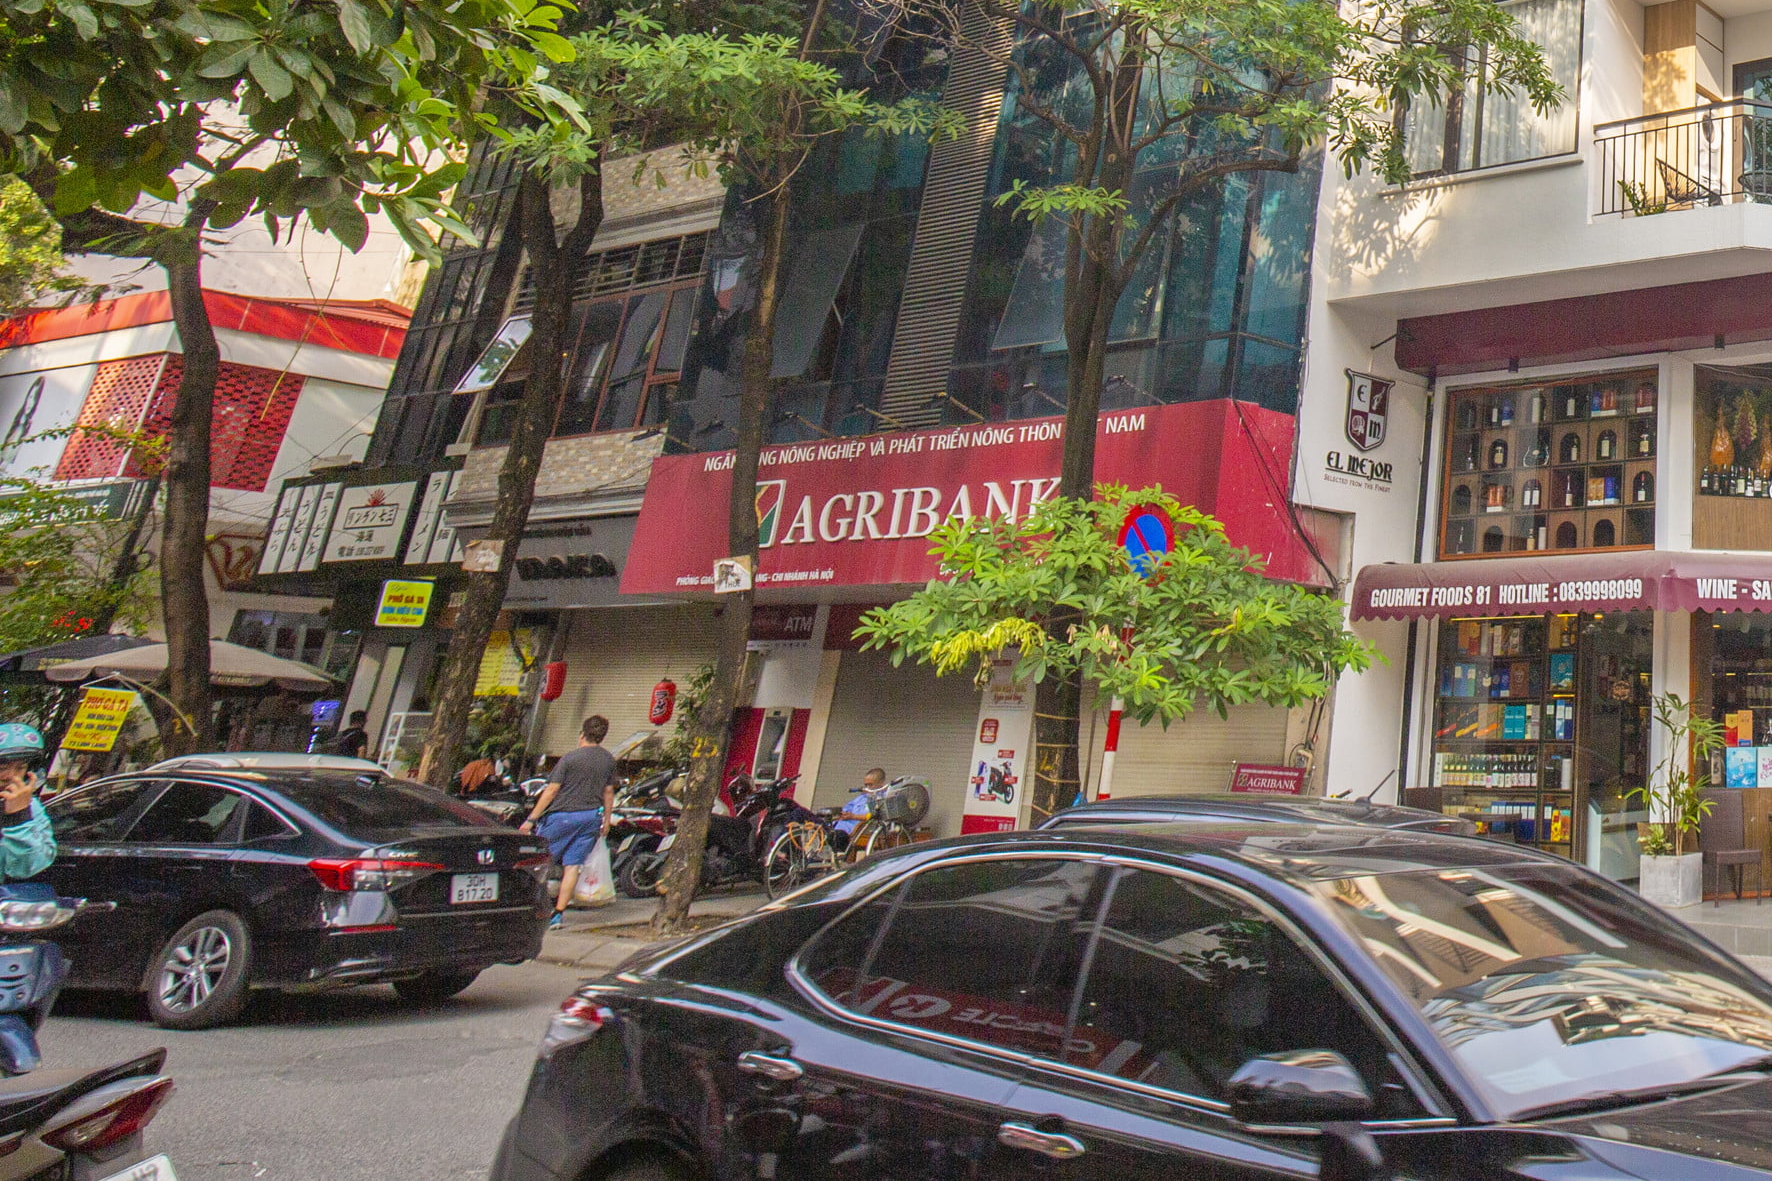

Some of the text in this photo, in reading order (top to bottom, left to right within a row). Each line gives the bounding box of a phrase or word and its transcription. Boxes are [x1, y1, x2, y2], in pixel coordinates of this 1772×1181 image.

[778, 446, 815, 465] NÔNG
[817, 441, 865, 462] NGHIỆP
[870, 437, 885, 457] VÀ
[889, 433, 925, 455] PHÁT
[929, 426, 969, 451] TRIỂN
[972, 426, 1014, 447] NÔNG
[1019, 423, 1062, 443] THÔN
[1105, 414, 1145, 434] NAM
[1327, 451, 1393, 481] EL MEJOR
[1371, 587, 1429, 608] GOURMET
[1431, 586, 1472, 606] FOODS
[1476, 585, 1491, 605] 81
[1499, 583, 1549, 604] HOTLINE
[1697, 578, 1737, 599] WINE
[784, 617, 813, 632] ATM
[1247, 777, 1297, 790] AGRIBANK
